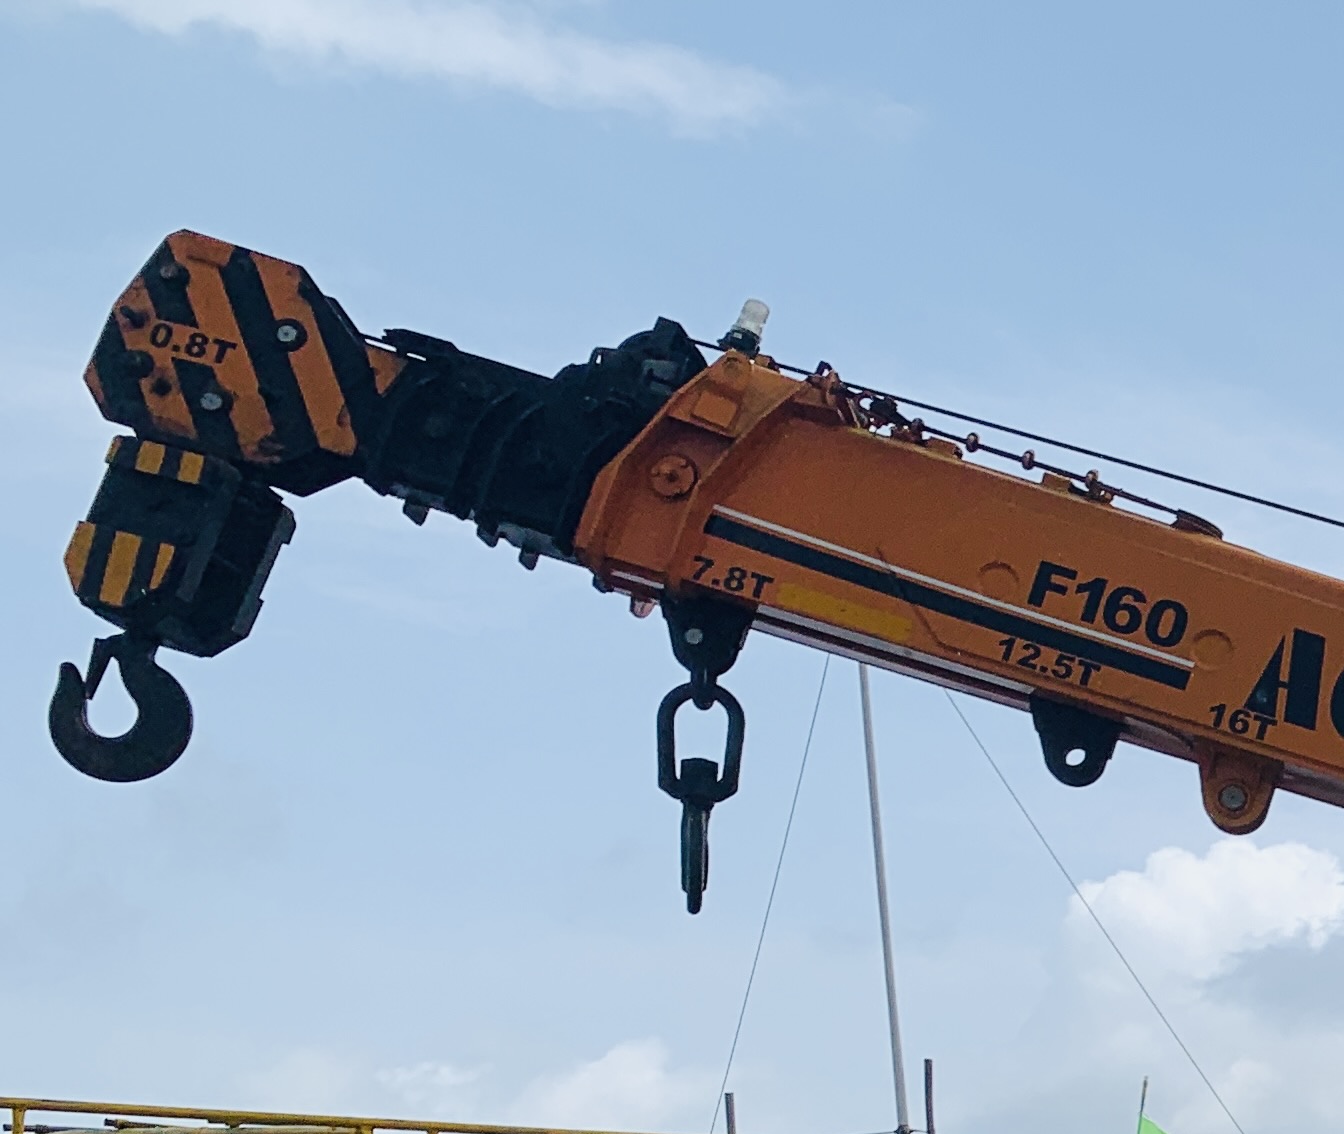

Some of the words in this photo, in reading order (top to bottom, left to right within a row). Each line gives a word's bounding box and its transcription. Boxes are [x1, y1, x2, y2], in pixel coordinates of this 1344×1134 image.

[149, 322, 239, 365] 0.8T
[692, 554, 776, 600] 7.8T
[1026, 559, 1189, 648] F160
[998, 636, 1102, 688] 12.5T
[1208, 703, 1279, 742] 16T
